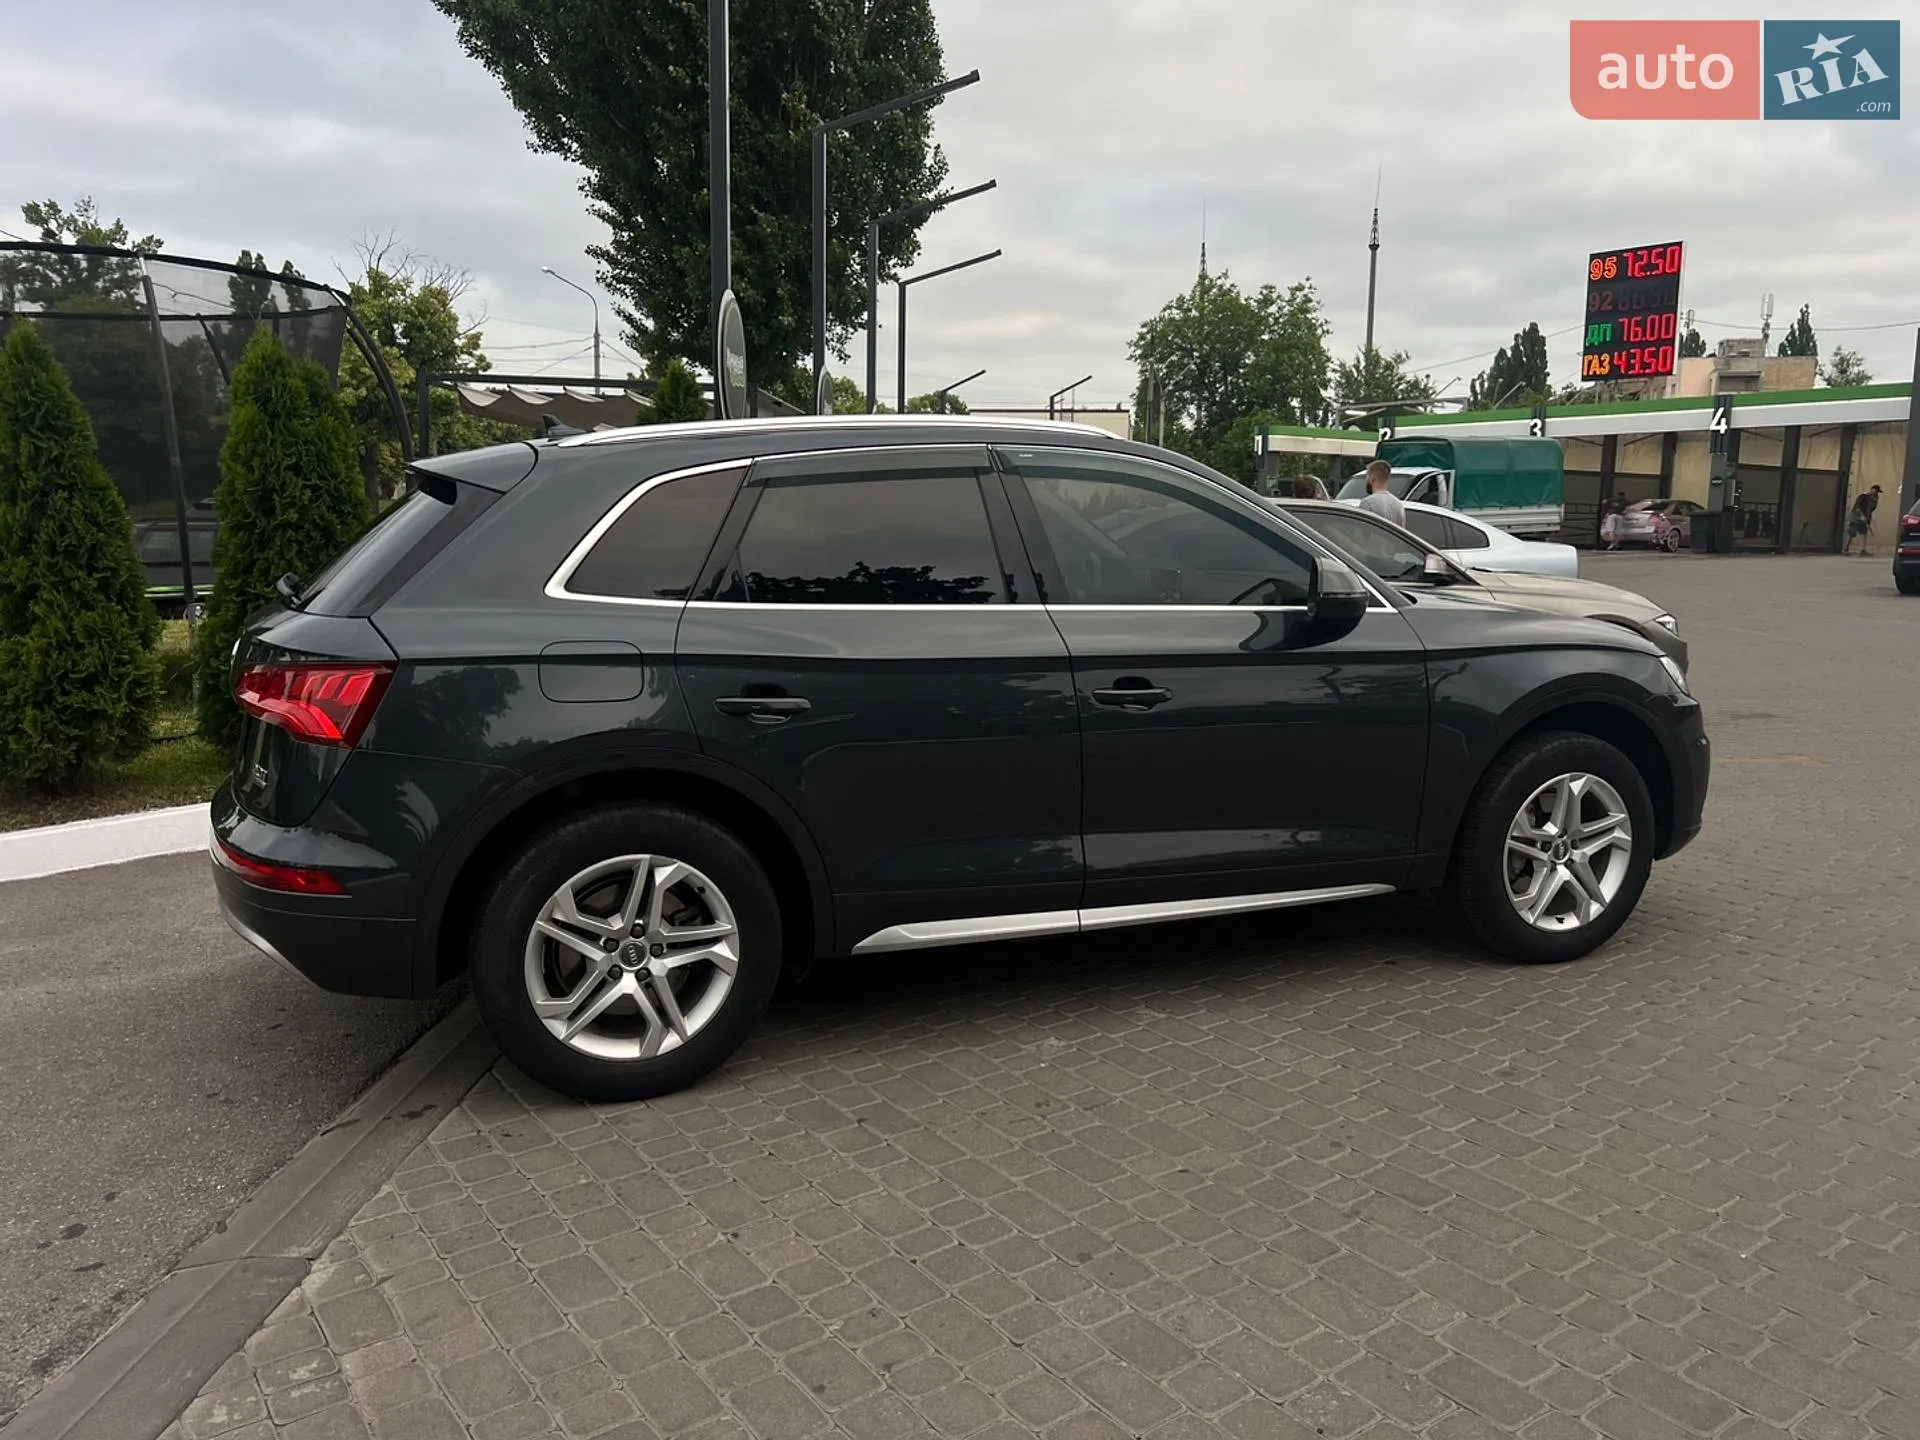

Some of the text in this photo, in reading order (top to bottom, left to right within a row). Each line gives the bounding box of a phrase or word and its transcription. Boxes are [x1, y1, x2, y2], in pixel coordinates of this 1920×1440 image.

[1590, 256, 1618, 281] 95
[1588, 290, 1614, 312] 92
[1586, 313, 1675, 346] ДП 76.00
[1583, 346, 1673, 376] ГАЗ 43.50
[1528, 418, 1542, 437] 3
[1709, 406, 1728, 434] 4
